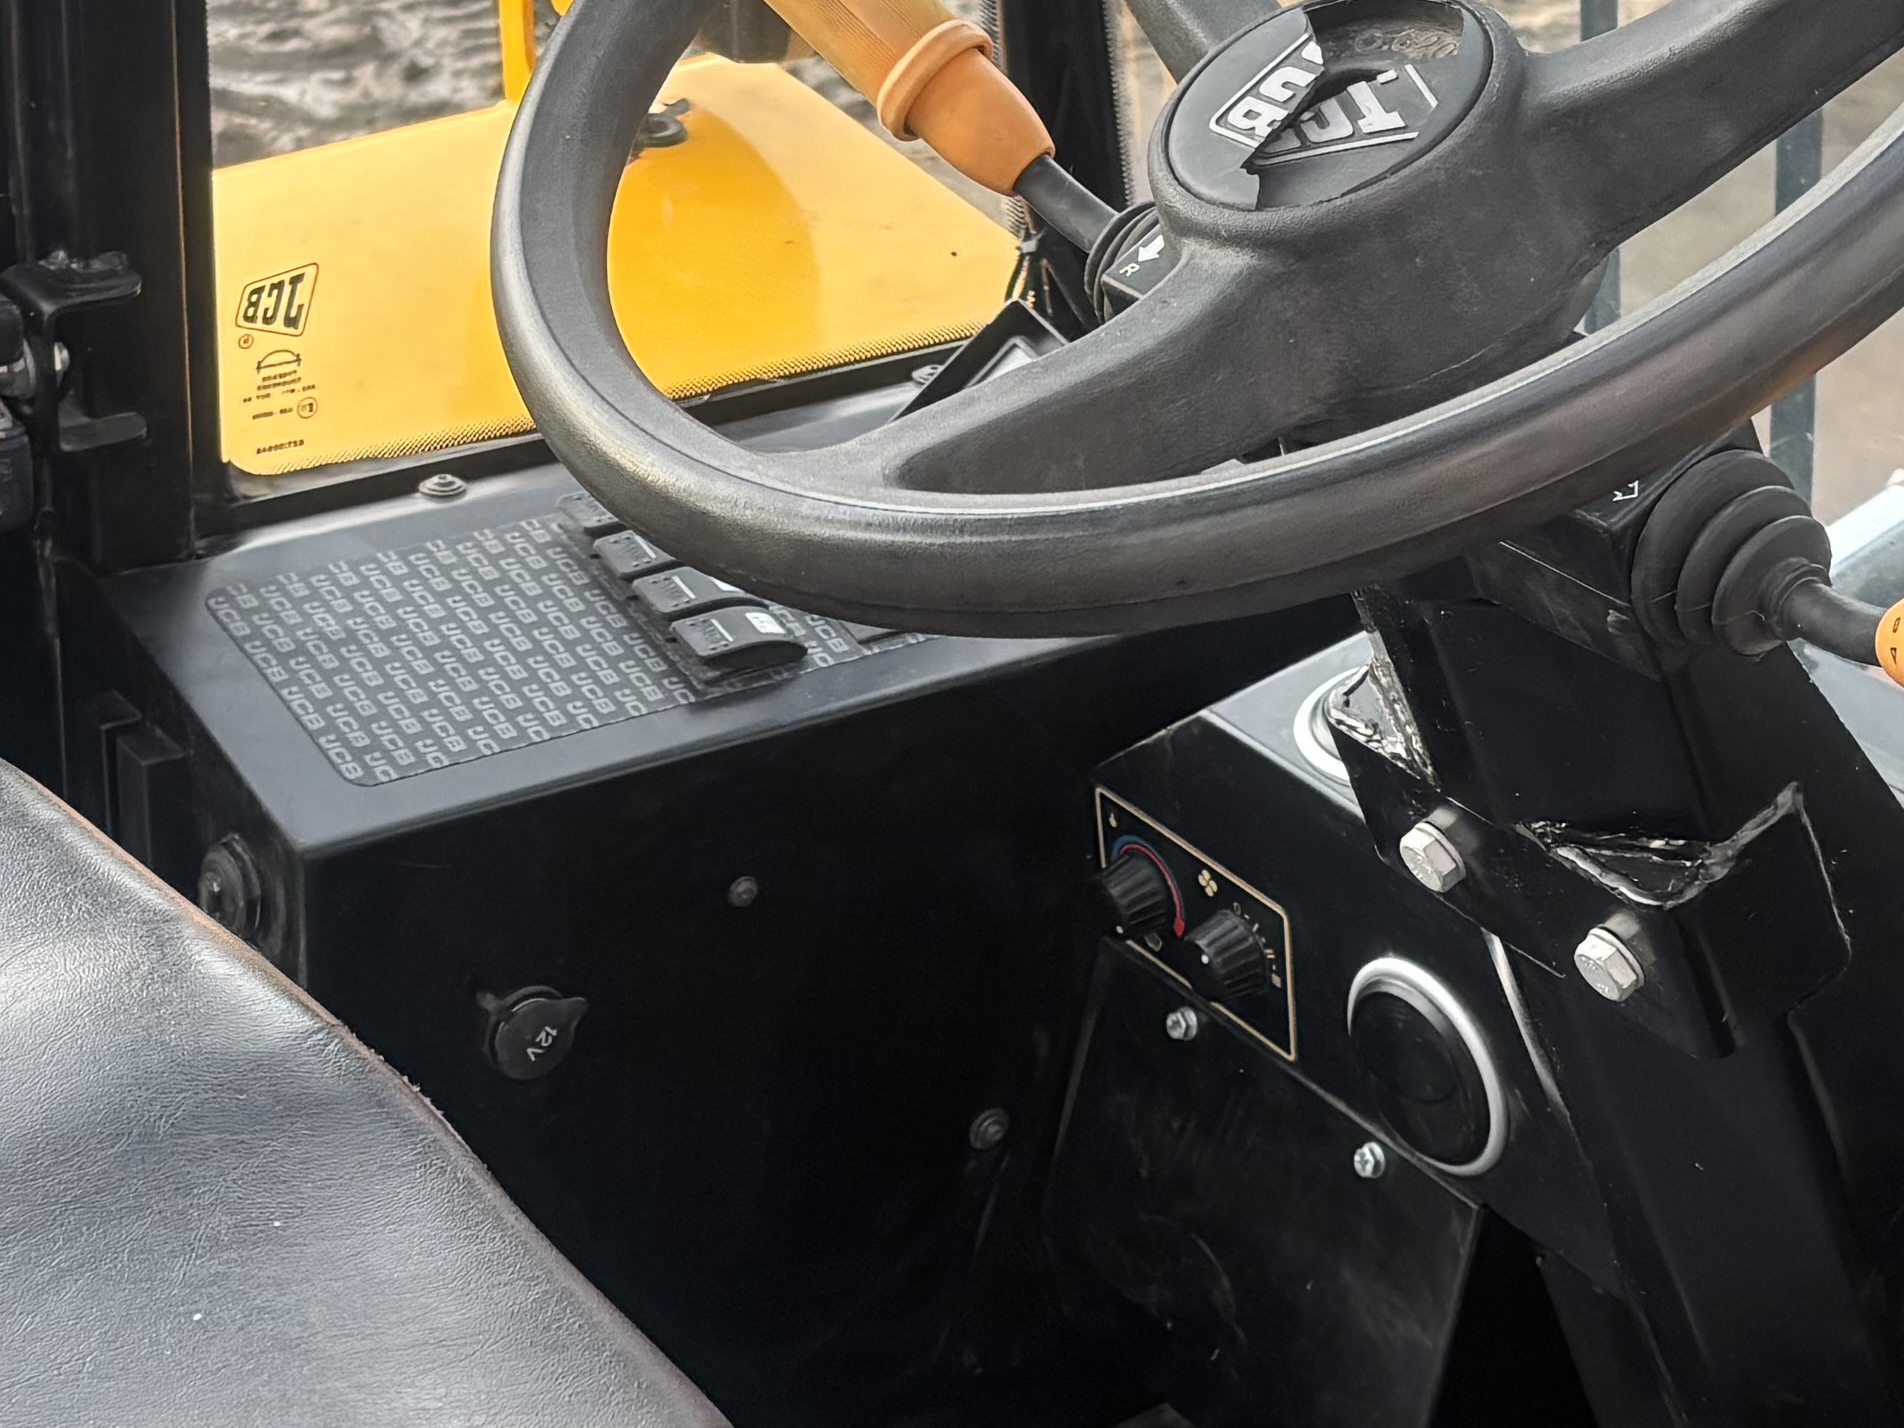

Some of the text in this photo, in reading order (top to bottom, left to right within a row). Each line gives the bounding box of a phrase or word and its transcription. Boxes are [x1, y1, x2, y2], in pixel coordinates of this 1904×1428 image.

[260, 585, 415, 765] JCB JCB JCB JCB
[303, 602, 346, 640] JCB
[340, 646, 384, 687] JCB
[378, 692, 422, 734] JCB
[310, 574, 467, 752] JCB JCB JCB JCB
[353, 590, 396, 629] JCB
[391, 634, 434, 674] JCB
[428, 680, 473, 721] JCB
[360, 564, 518, 739] JCB JCB JCB JCB
[403, 580, 446, 618] JCB
[440, 623, 484, 663] JCB
[478, 668, 523, 709] JCB
[409, 553, 567, 726] JCB JCB JCB JCB
[452, 569, 494, 607] JCB
[489, 612, 533, 651] JCB
[527, 656, 572, 697] JCB
[457, 542, 616, 714] JCB JCB JCB JCB
[499, 558, 542, 596] JCB
[537, 601, 581, 640] JCB
[575, 644, 620, 685] JCB
[505, 532, 547, 569] JCB
[542, 574, 585, 612] JCB
[580, 617, 624, 656] JCB
[619, 661, 664, 701] JCB
[546, 547, 589, 585] JCB
[584, 590, 628, 628] JCB
[623, 633, 667, 672] JCB
[208, 597, 363, 779] JCB JCB JCB JCB
[252, 613, 295, 652] JCB
[289, 658, 332, 699] JCB
[326, 704, 370, 747] JCB
[527, 1026, 557, 1061] 12V
